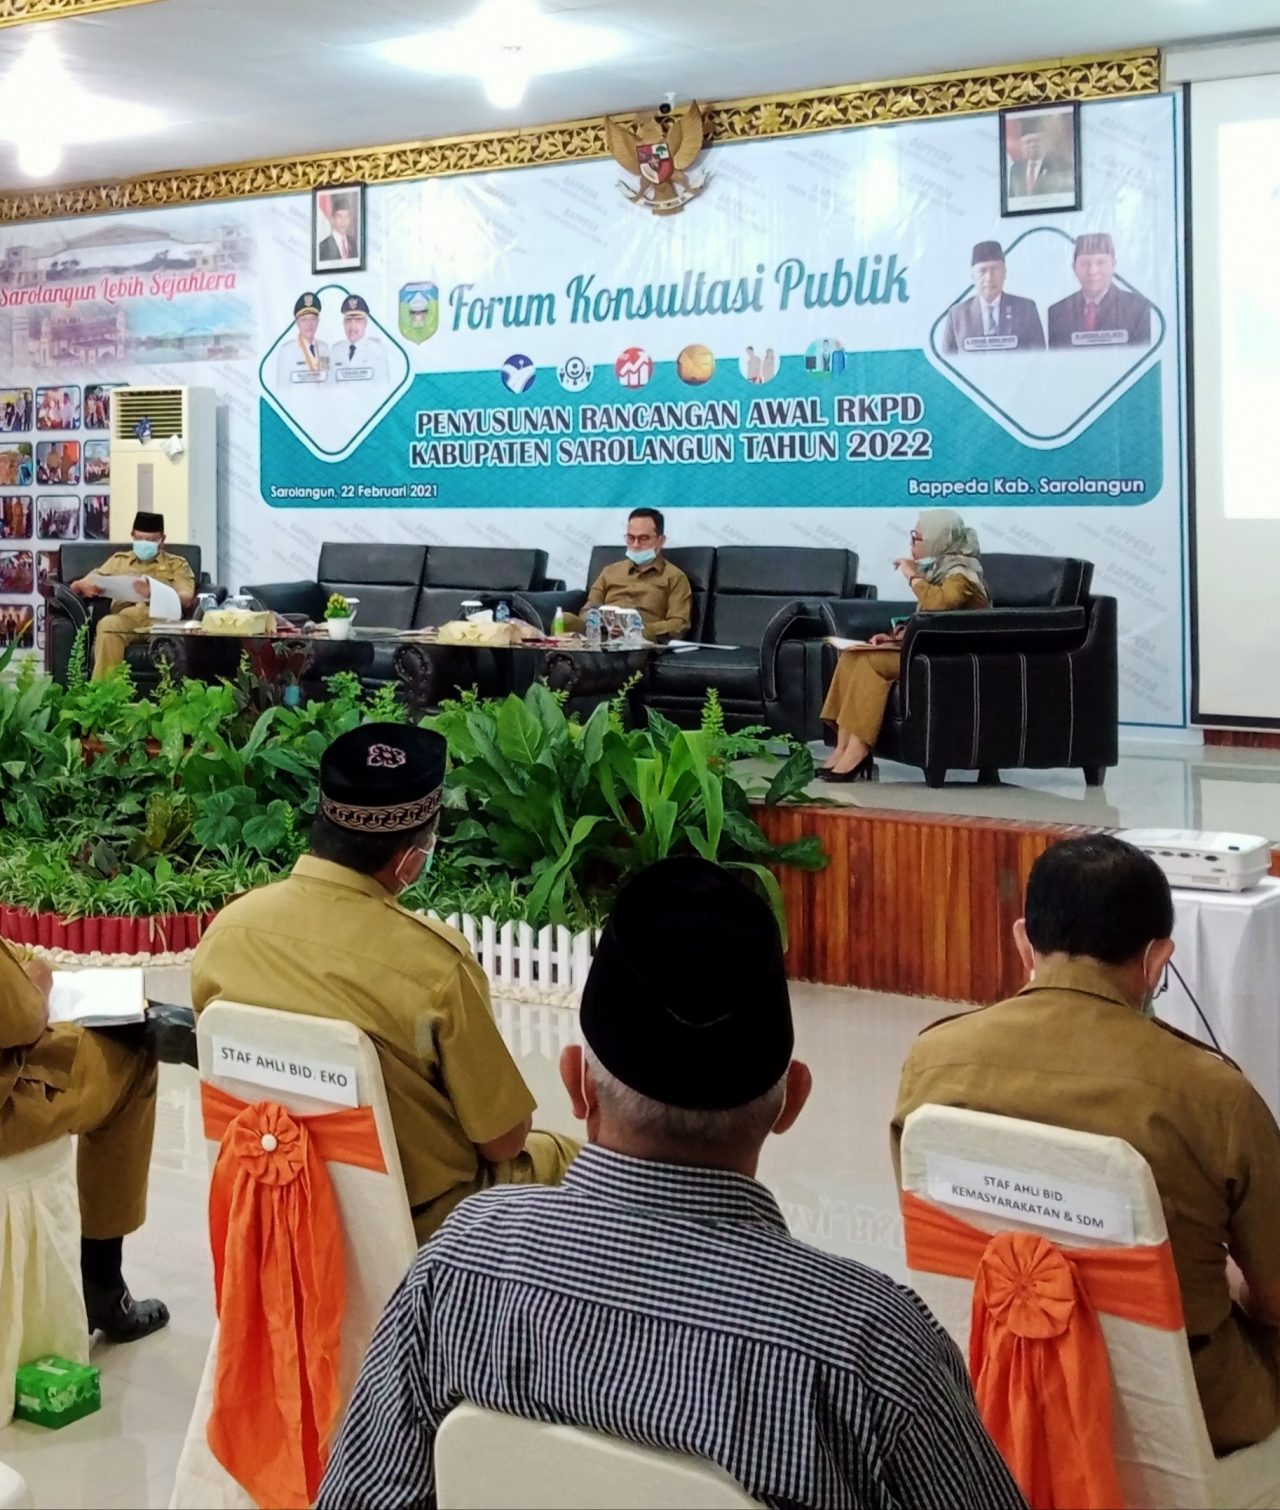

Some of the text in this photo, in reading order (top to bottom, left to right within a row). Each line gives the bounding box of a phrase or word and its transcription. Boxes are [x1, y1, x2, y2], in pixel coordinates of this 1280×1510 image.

[0, 270, 236, 307] Sarolangun Lebih Sejahtera
[449, 254, 911, 332] Forum Konsultasi Publik
[417, 396, 922, 436] PENYUSUNAN RANCANGAN AWAL RKPD
[410, 431, 931, 466] KABUPATEN SAROLANGUN TAHUN 2022
[270, 485, 438, 500] Sarolangun, 22 Februari 2021
[908, 477, 1144, 497] Bappeda Kab. Sarolangun
[220, 1047, 348, 1087] STAF AHLI BID. EKO
[983, 1175, 1011, 1190] STAF
[1014, 1183, 1040, 1197] AHLI
[951, 1184, 1105, 1229] KEMASYARAKATAN & SDM
